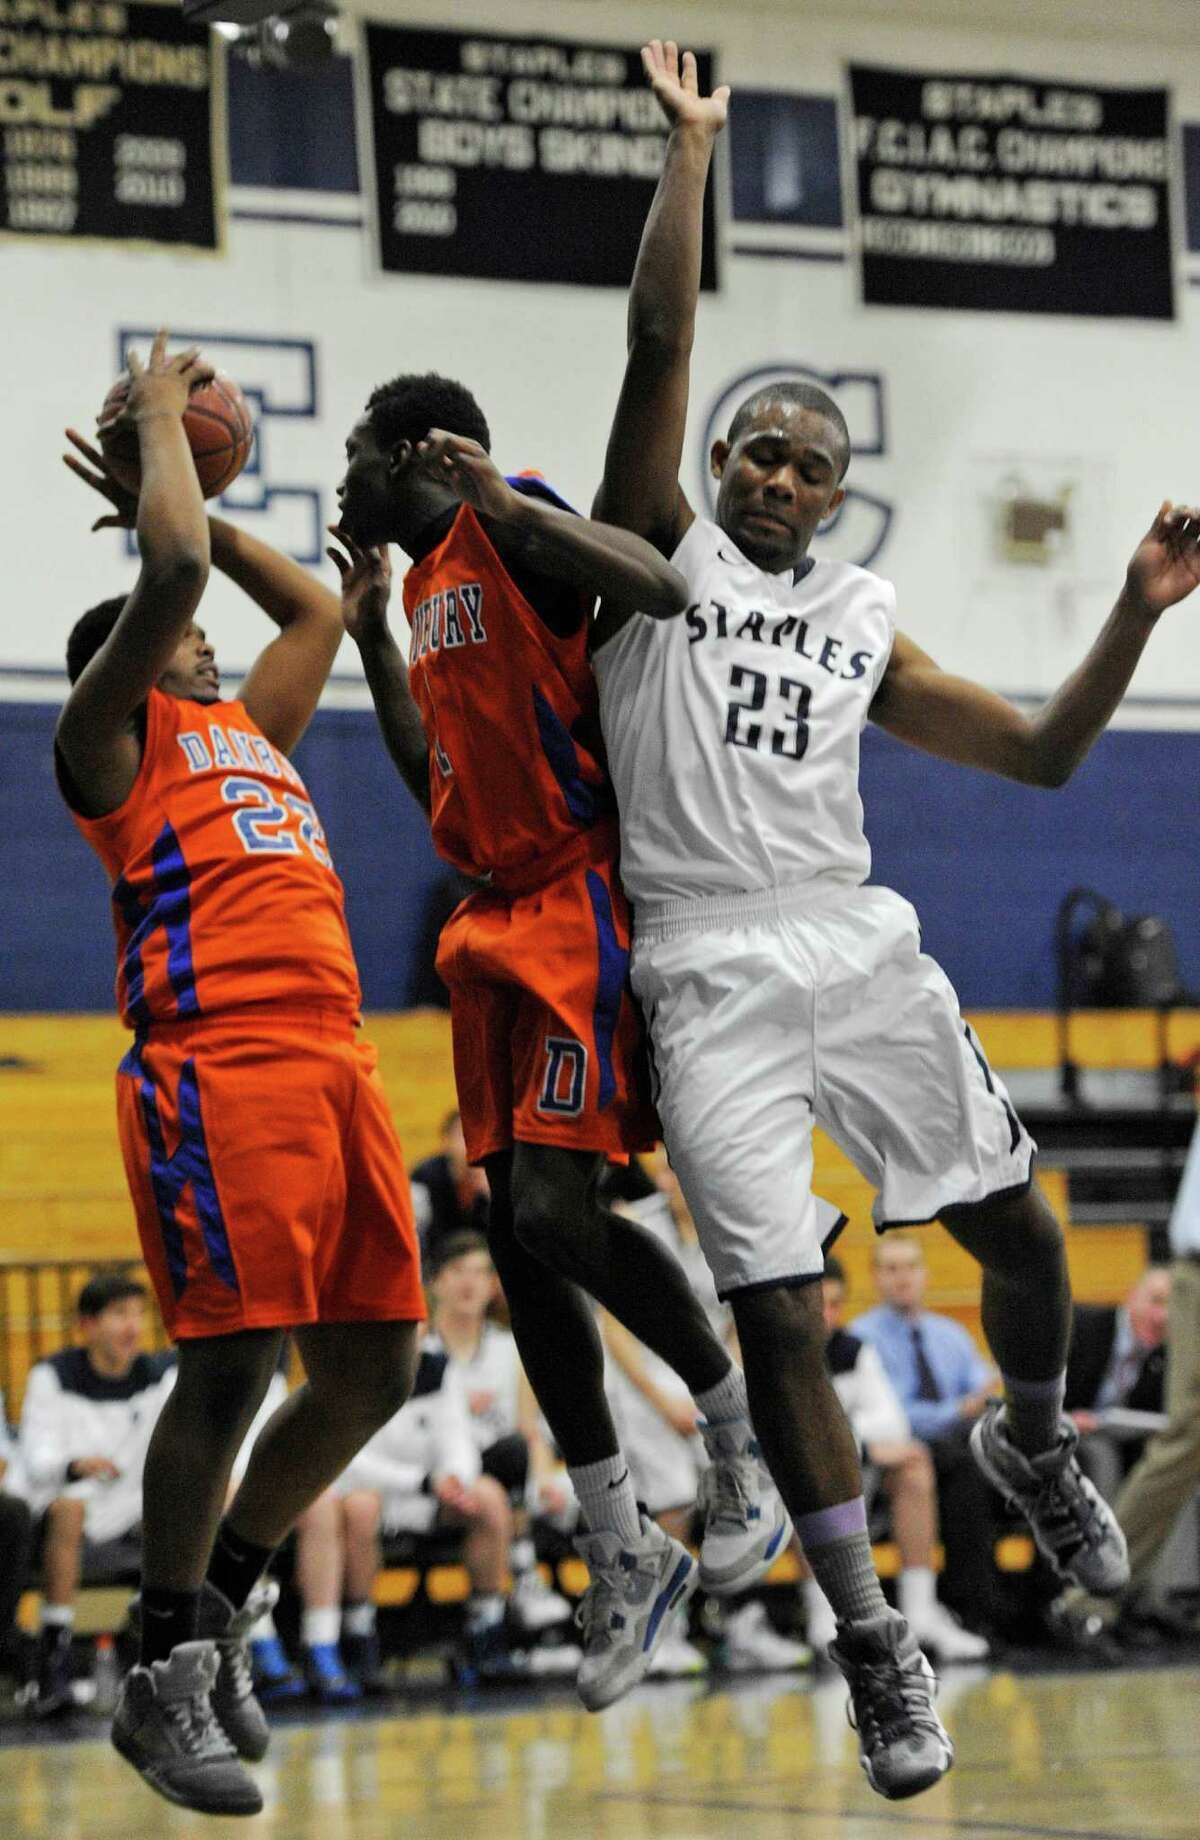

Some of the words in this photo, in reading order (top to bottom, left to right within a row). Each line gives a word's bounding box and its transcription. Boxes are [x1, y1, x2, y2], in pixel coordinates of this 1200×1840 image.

[921, 81, 1102, 130] STAPLES
[418, 120, 535, 169] BOYS
[870, 168, 1158, 229] GYMNASTICS
[685, 600, 872, 680] STAPLES
[725, 664, 812, 762] 23
[537, 1035, 588, 1117] D
